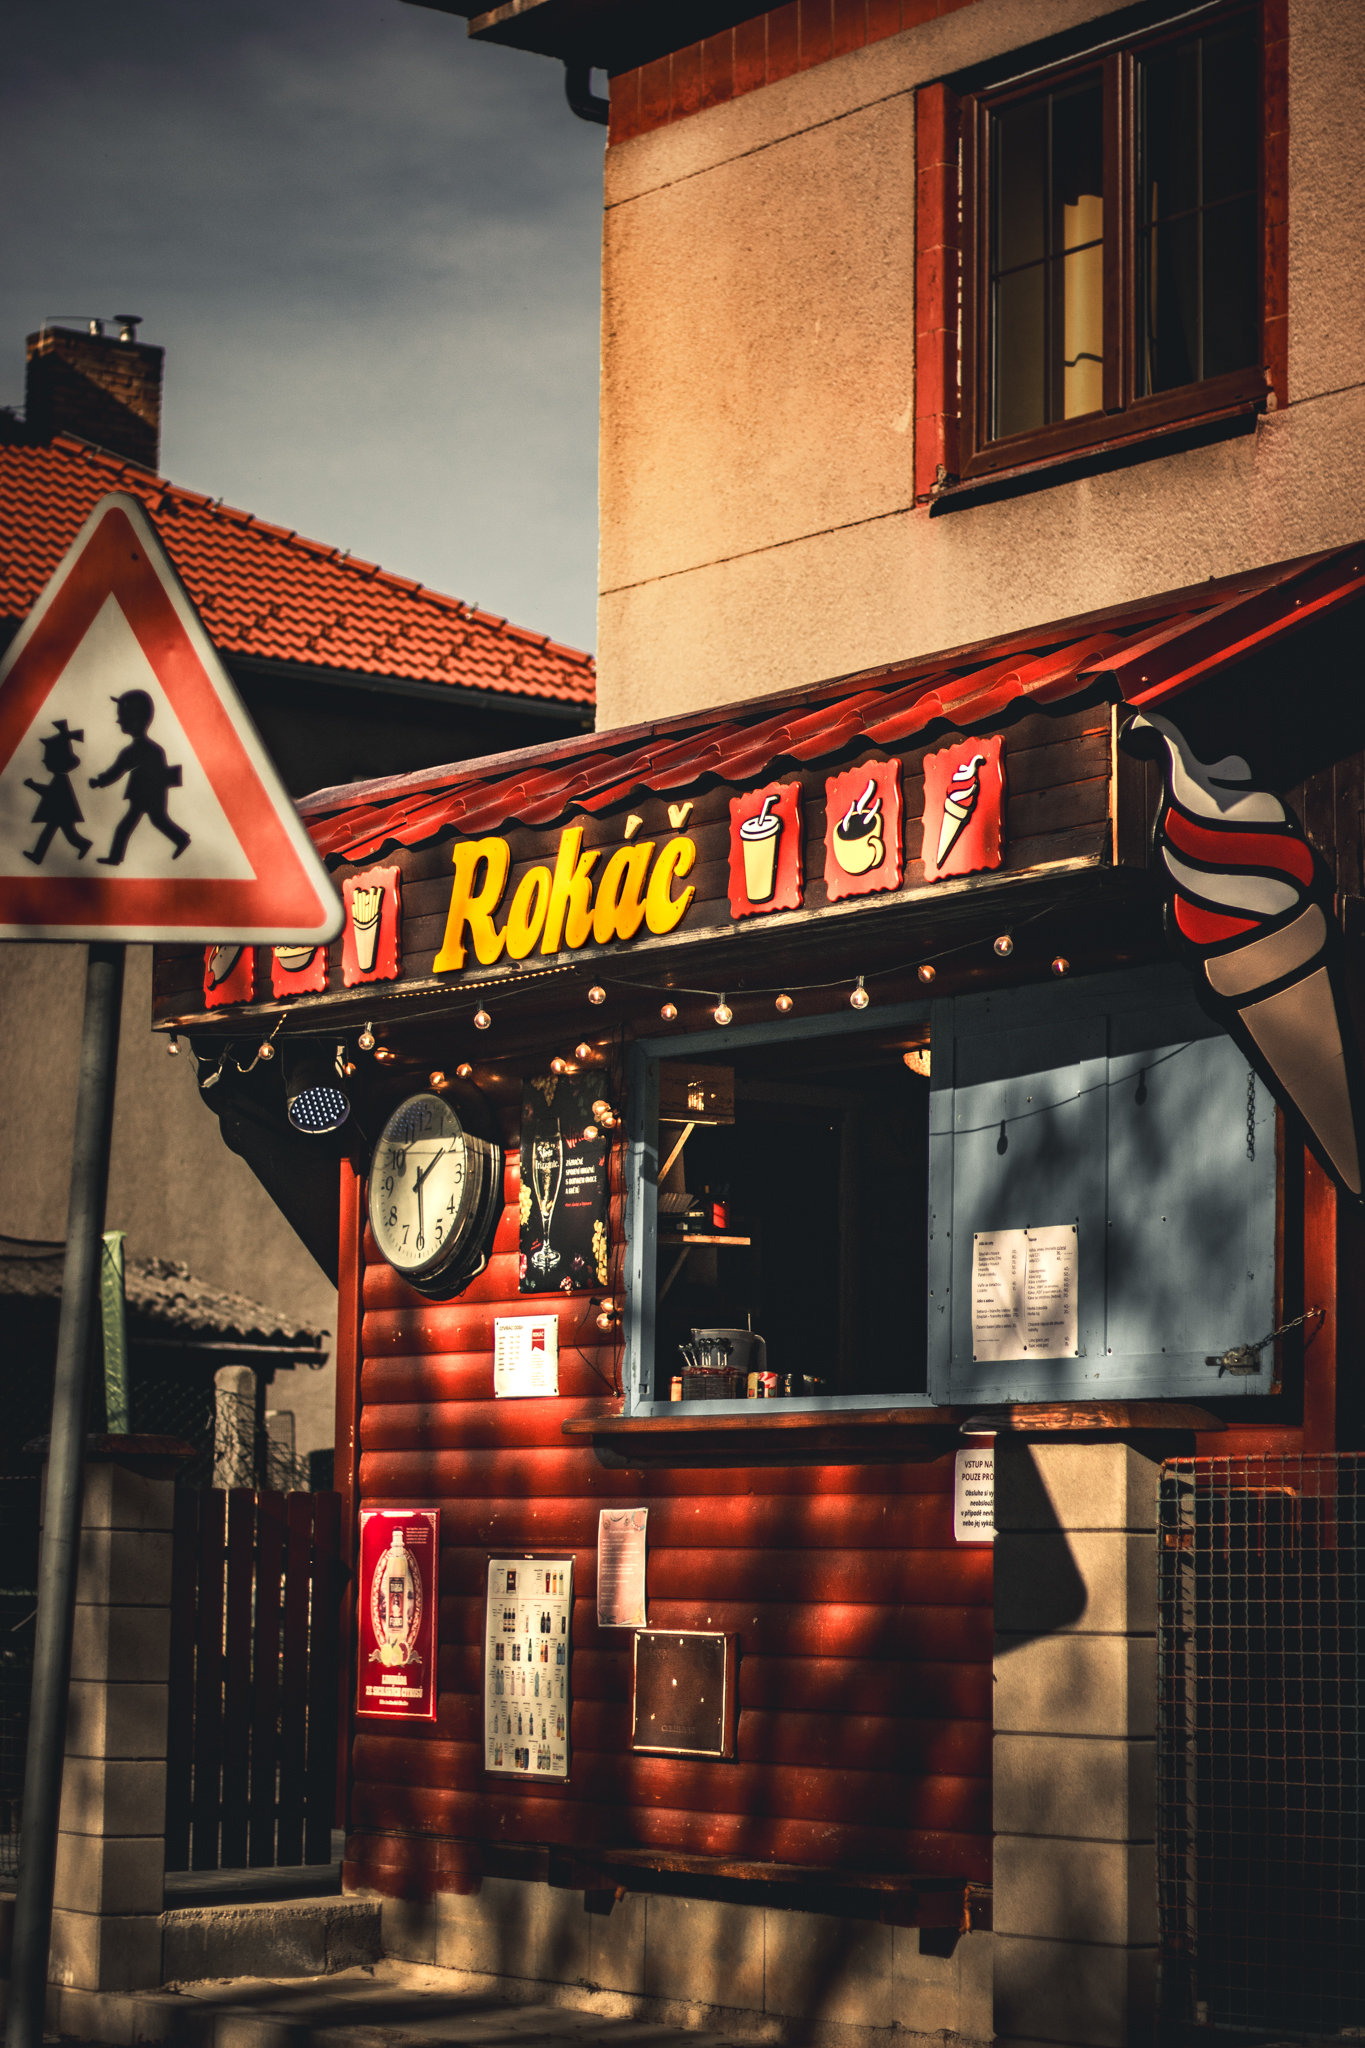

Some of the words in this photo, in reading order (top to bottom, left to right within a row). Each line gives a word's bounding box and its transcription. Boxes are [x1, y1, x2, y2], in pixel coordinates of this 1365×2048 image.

[433, 802, 697, 974] Rokáč
[419, 1111, 432, 1132] 12
[448, 1132, 457, 1153] 2
[392, 1148, 406, 1171] 10
[454, 1163, 462, 1184] 3
[385, 1176, 394, 1199] 9
[446, 1194, 455, 1215] 4
[389, 1205, 397, 1227] 8
[402, 1224, 410, 1245] 7
[434, 1218, 443, 1240] 5
[965, 1461, 983, 1469] VSTUP
[985, 1461, 994, 1469] NA
[962, 1473, 981, 1481] POUZE
[982, 1473, 995, 1481] PRO
